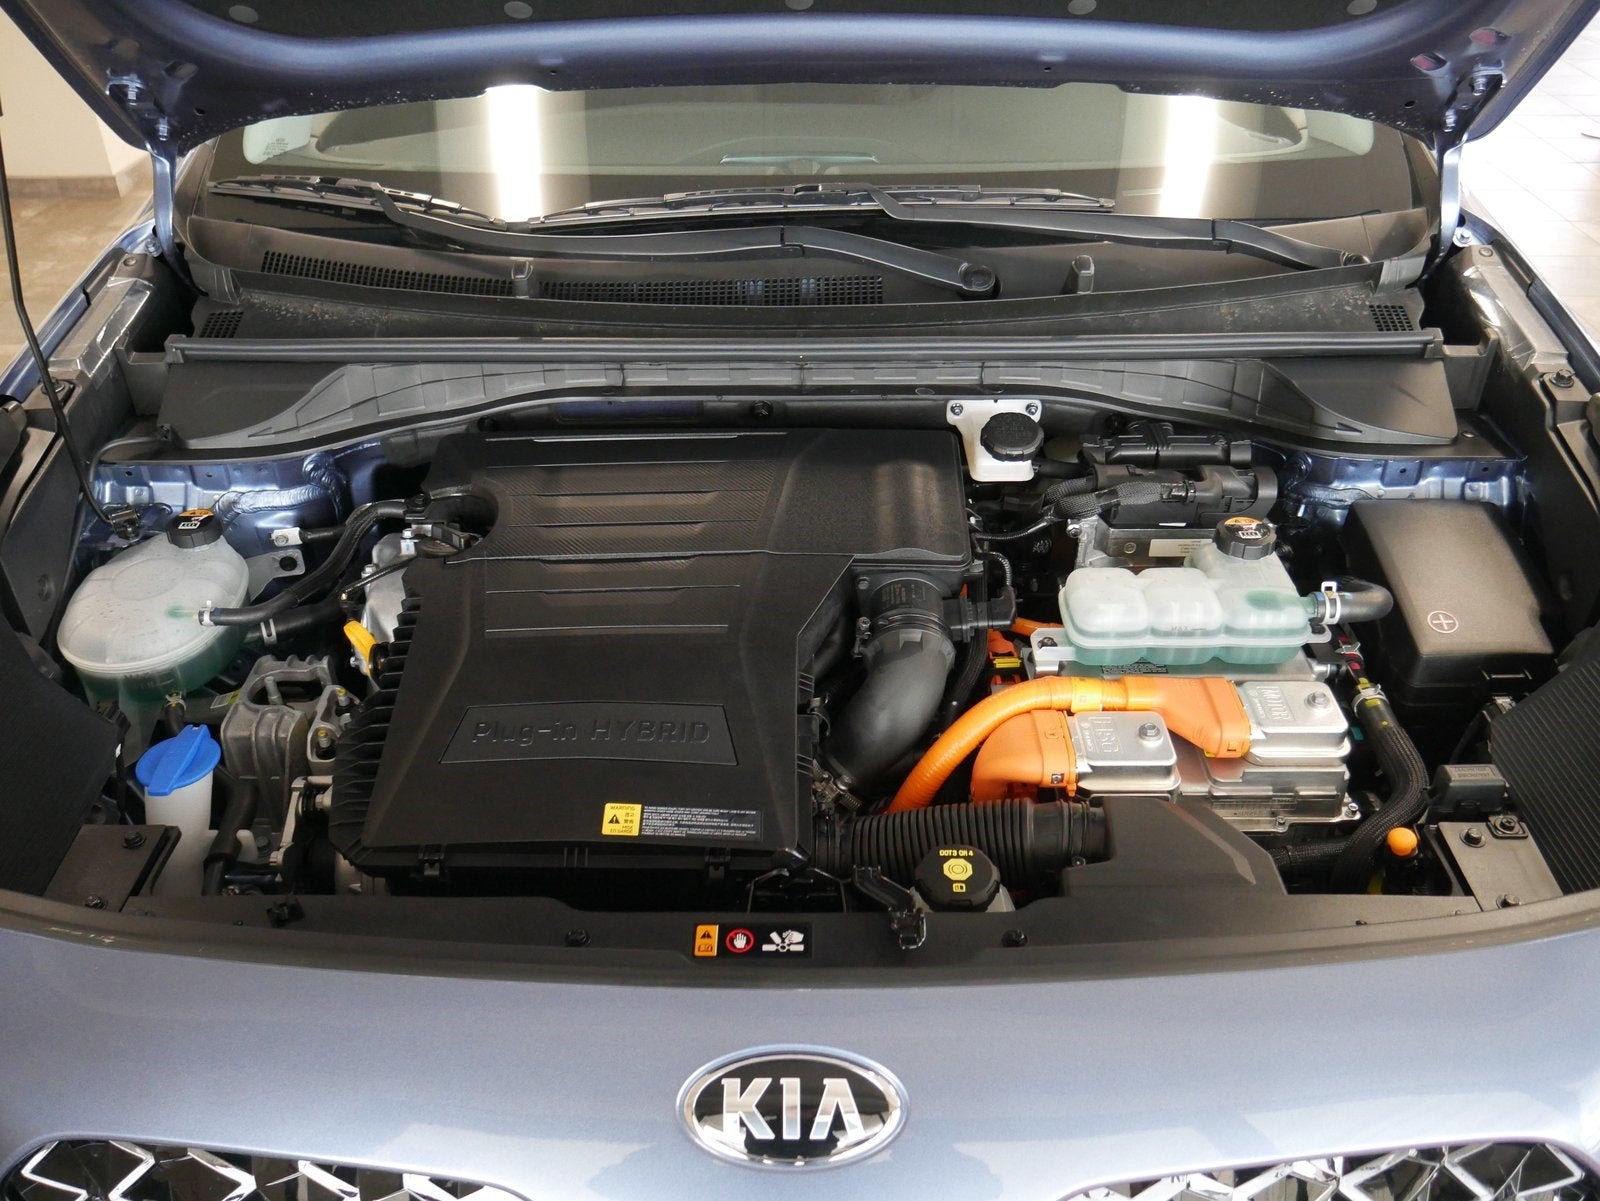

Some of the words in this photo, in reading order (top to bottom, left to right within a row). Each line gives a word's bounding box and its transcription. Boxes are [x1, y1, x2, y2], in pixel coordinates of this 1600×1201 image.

[472, 721, 578, 747] Plug-in
[591, 719, 710, 744] HYBRID
[721, 1077, 867, 1140] KIA
